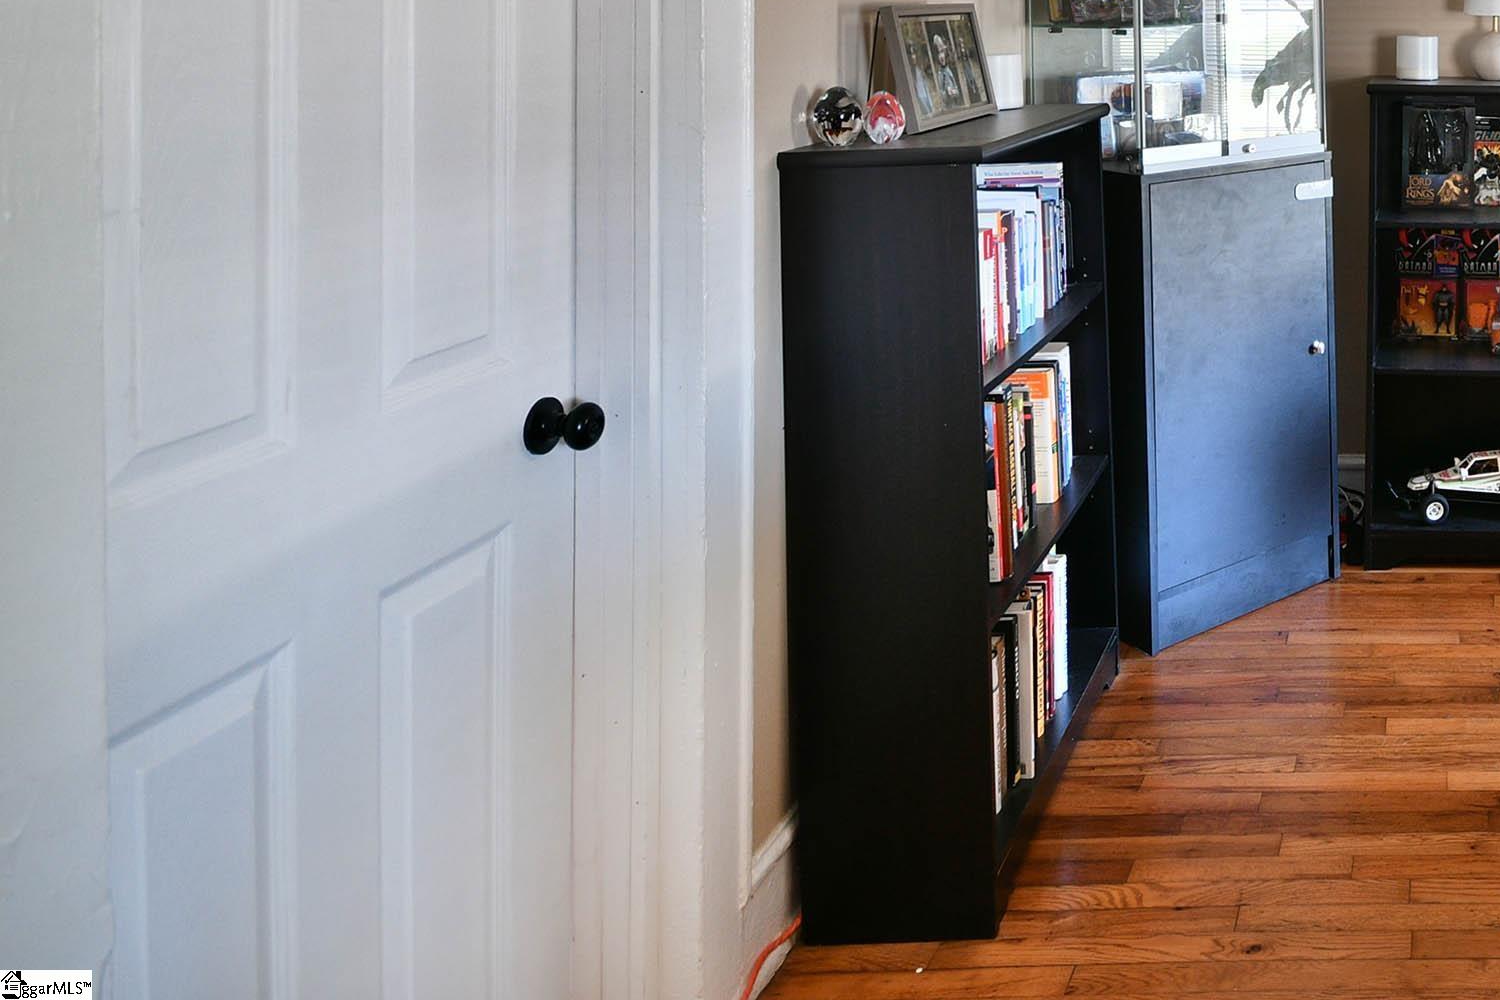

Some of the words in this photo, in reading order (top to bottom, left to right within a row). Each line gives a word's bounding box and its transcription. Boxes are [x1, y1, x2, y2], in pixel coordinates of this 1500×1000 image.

[1409, 175, 1433, 189] LORD
[1406, 186, 1435, 199] RINGS
[1398, 260, 1433, 271] BATMAN
[1463, 261, 1497, 271] BATMAN
